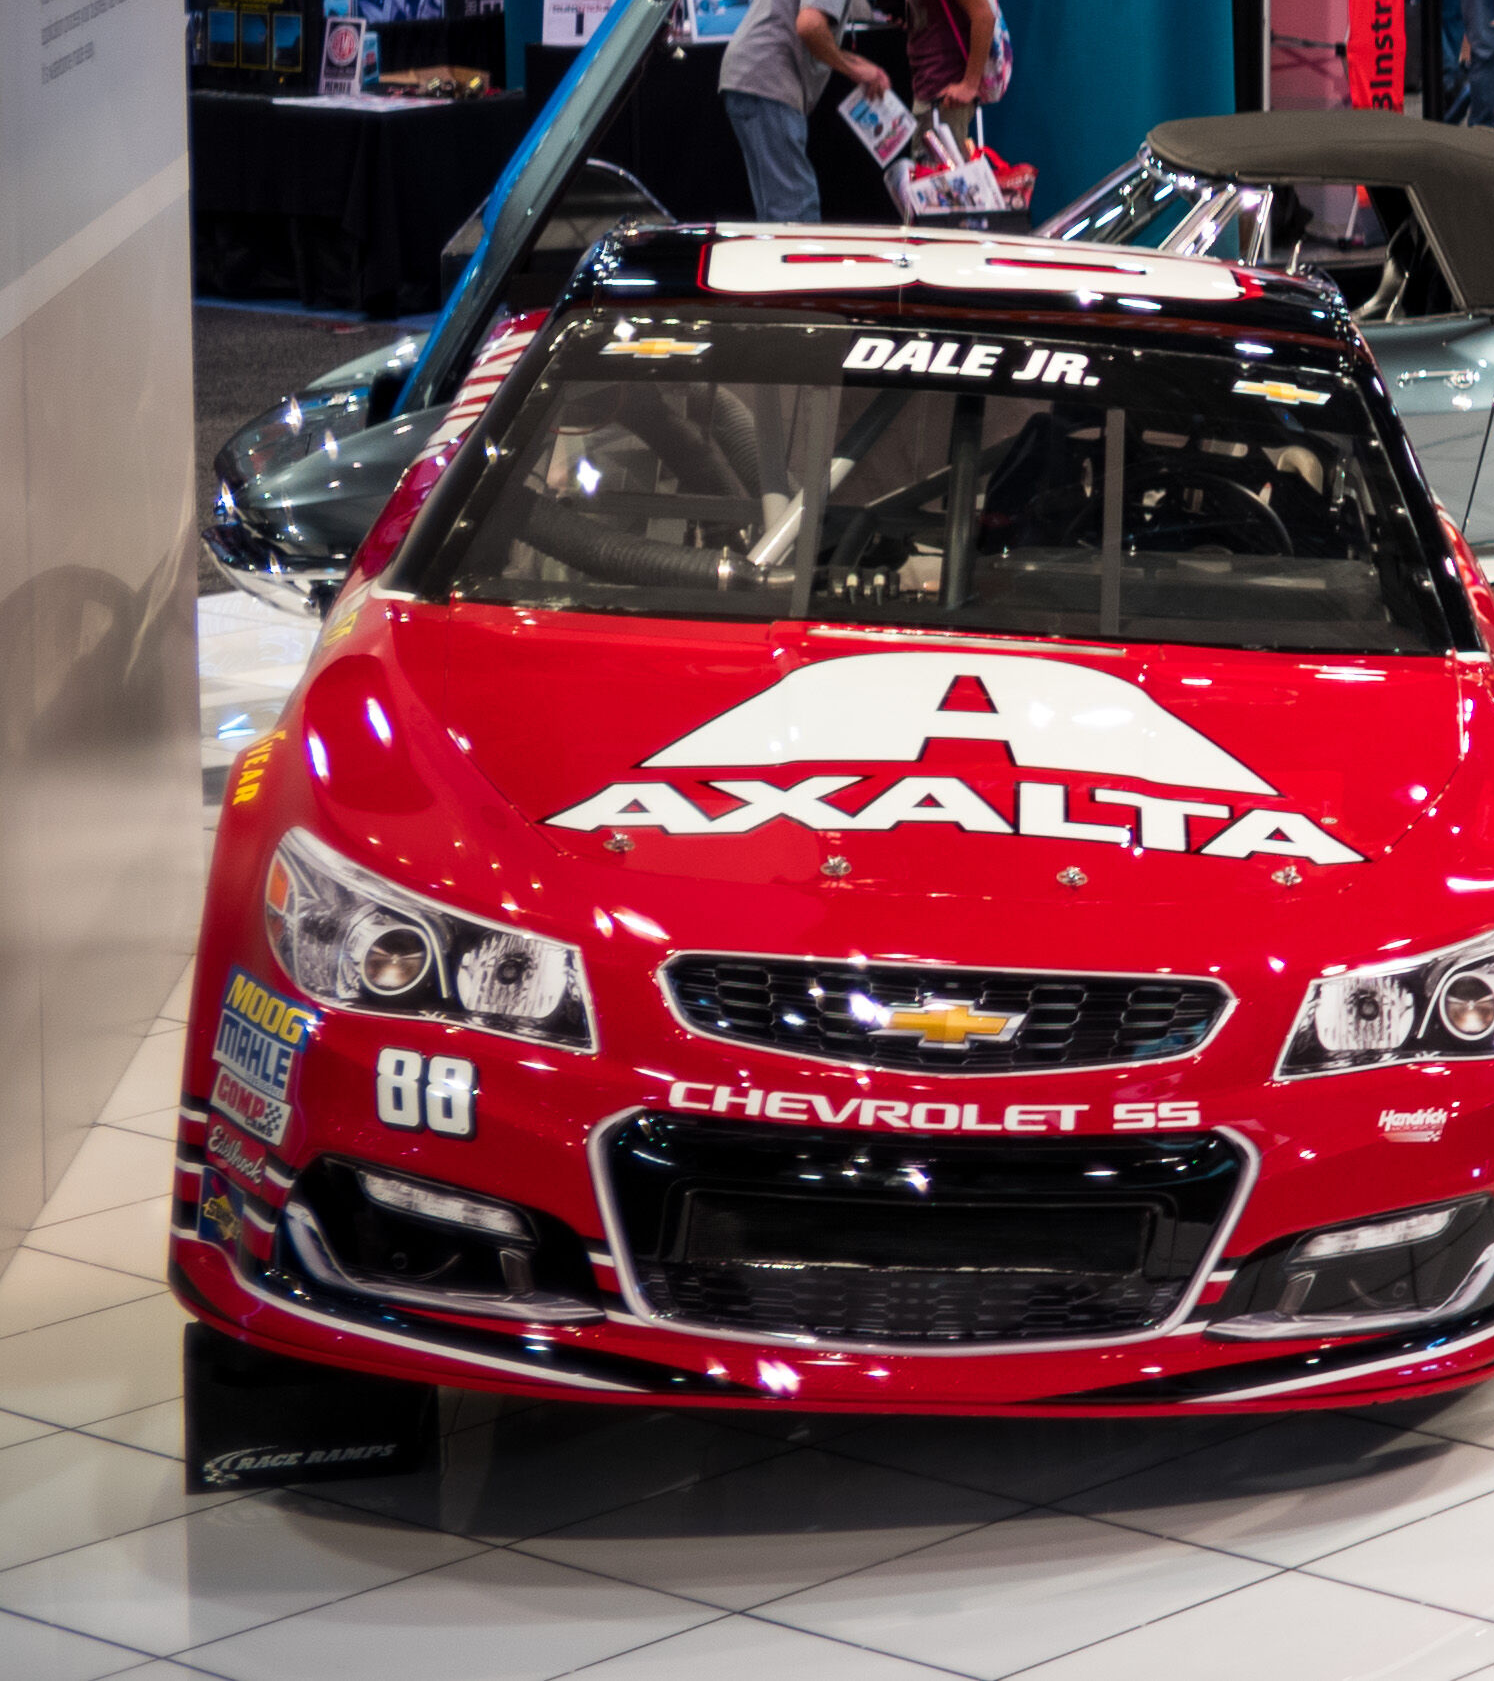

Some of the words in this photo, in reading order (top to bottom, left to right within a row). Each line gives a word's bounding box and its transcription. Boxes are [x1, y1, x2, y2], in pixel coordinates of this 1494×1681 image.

[843, 334, 1003, 381] DALE
[1013, 341, 1100, 386] JR.
[543, 773, 1368, 865] AXALTA
[225, 972, 318, 1045] MOOG
[215, 1011, 293, 1092] MAHLE
[215, 1072, 267, 1121] COMP
[376, 1046, 477, 1139] 88
[667, 1080, 1090, 1132] CHEVROLET
[1113, 1101, 1200, 1130] SS
[1378, 1108, 1448, 1129] Hendrick
[237, 1447, 304, 1471] RACE
[305, 1442, 398, 1466] RAMPS
